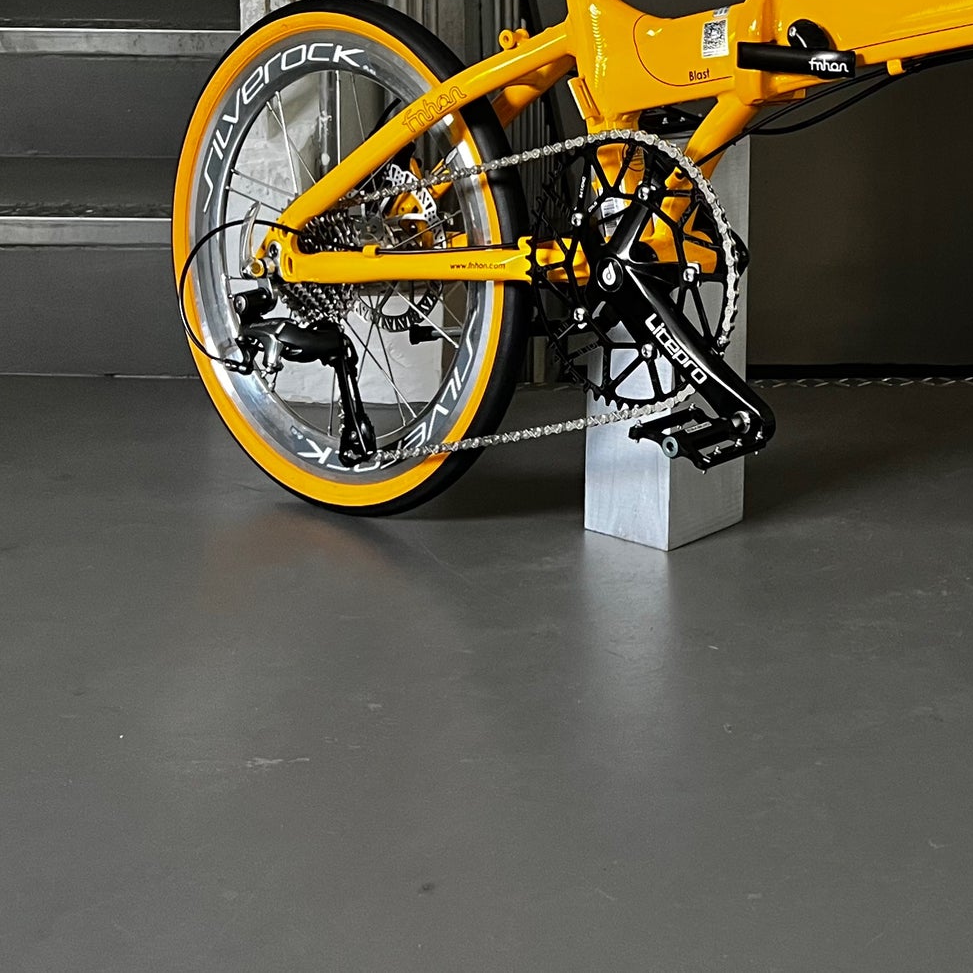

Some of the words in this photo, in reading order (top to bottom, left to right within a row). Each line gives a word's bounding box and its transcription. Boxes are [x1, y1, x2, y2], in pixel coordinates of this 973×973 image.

[808, 57, 849, 74] fnhon
[688, 68, 710, 82] Blast
[645, 313, 707, 384] Litepro
